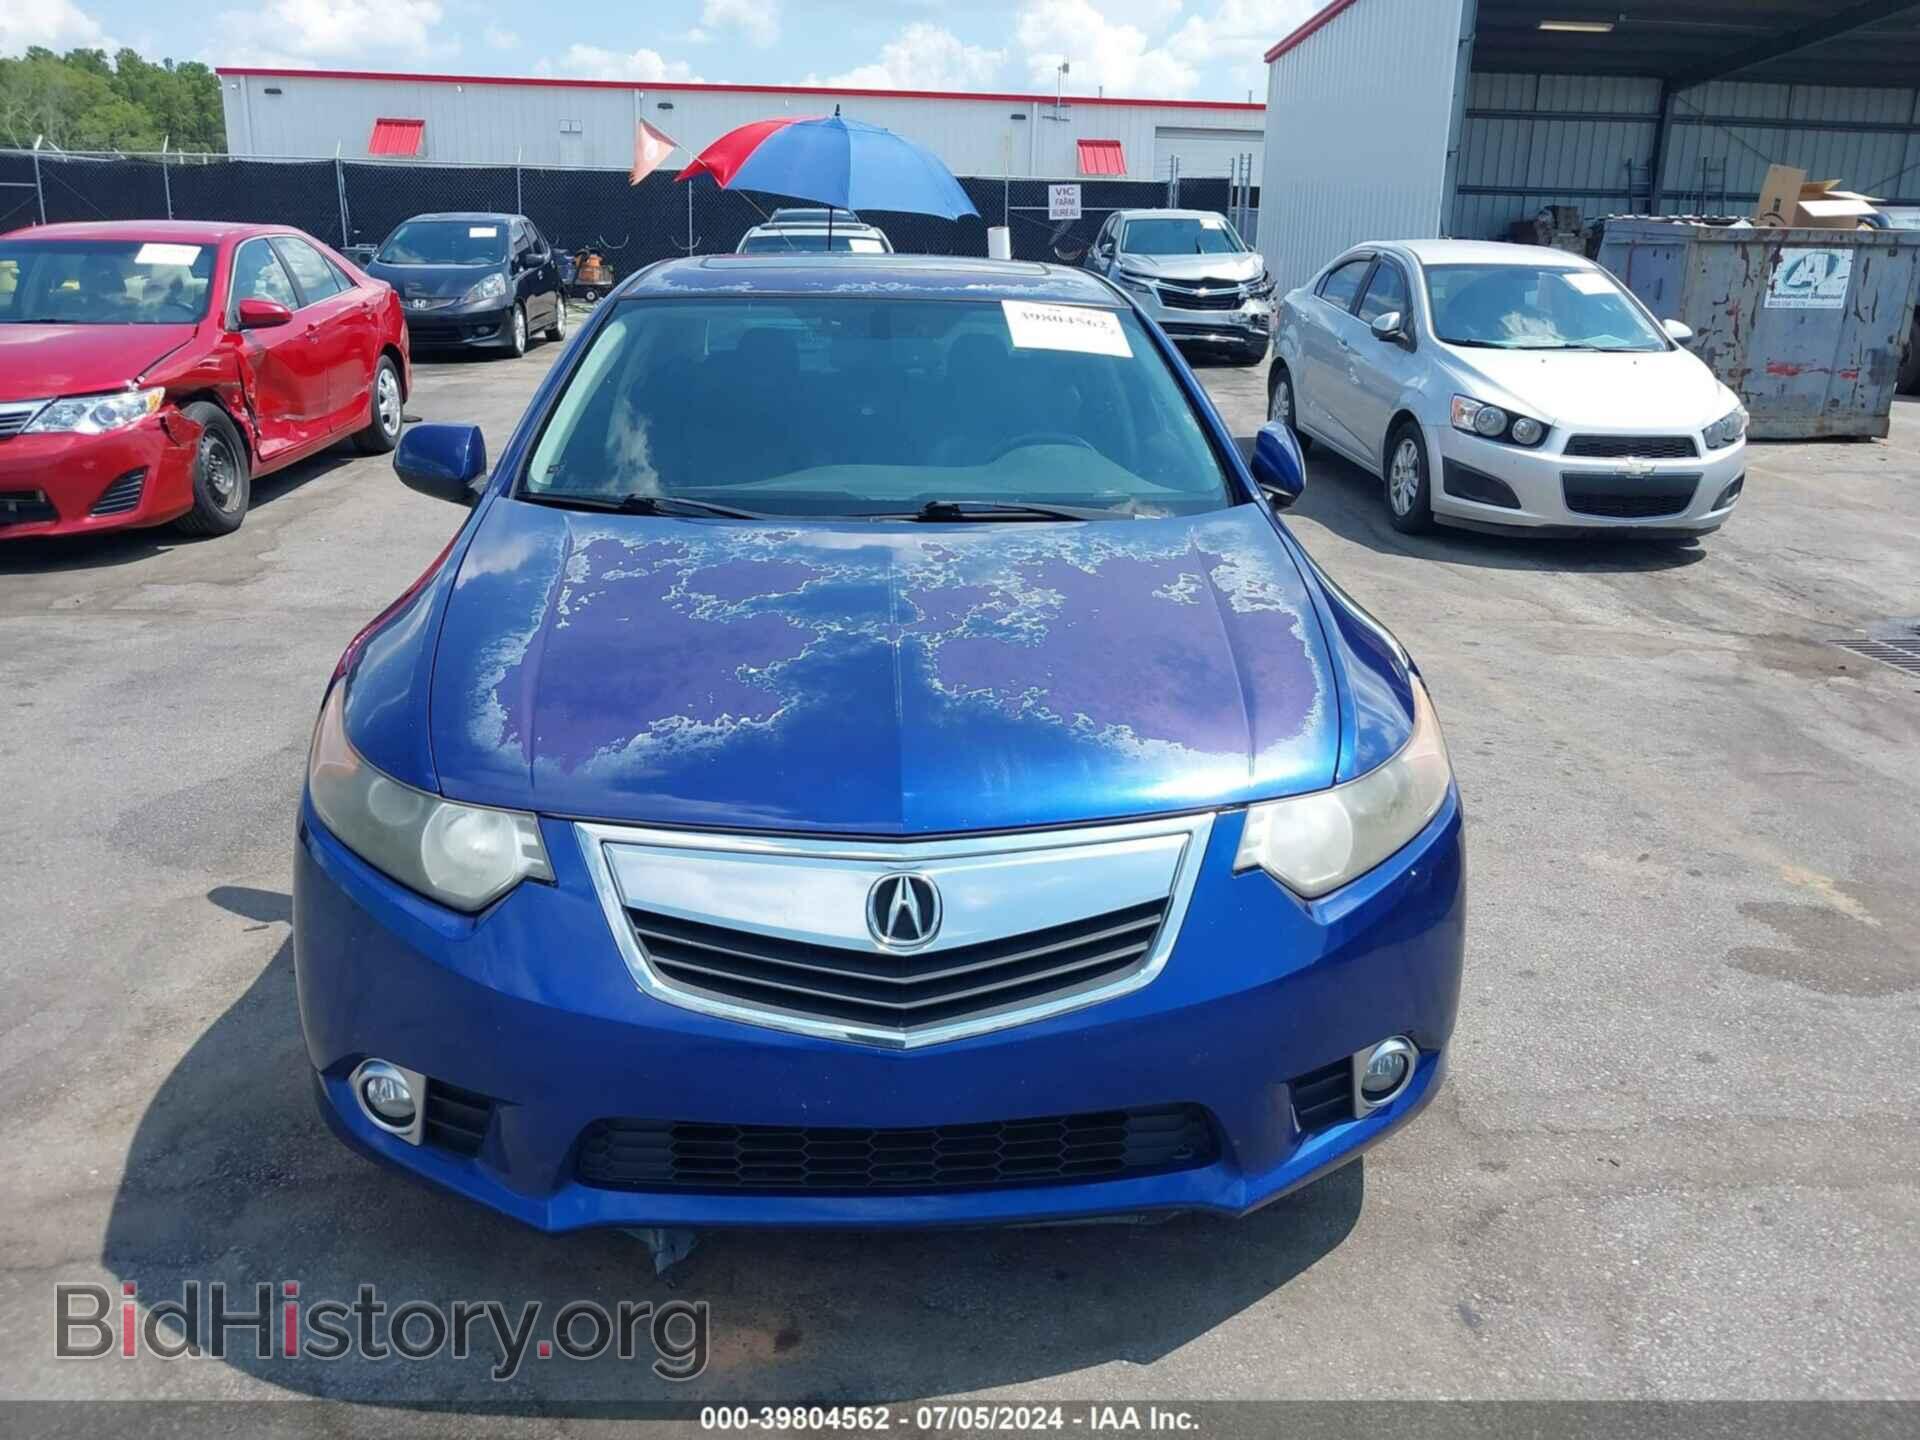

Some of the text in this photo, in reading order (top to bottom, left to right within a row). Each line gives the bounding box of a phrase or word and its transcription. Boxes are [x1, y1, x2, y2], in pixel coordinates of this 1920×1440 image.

[1056, 187, 1074, 196] VIC
[1055, 197, 1075, 206] FARM
[1052, 207, 1079, 217] BUREAU
